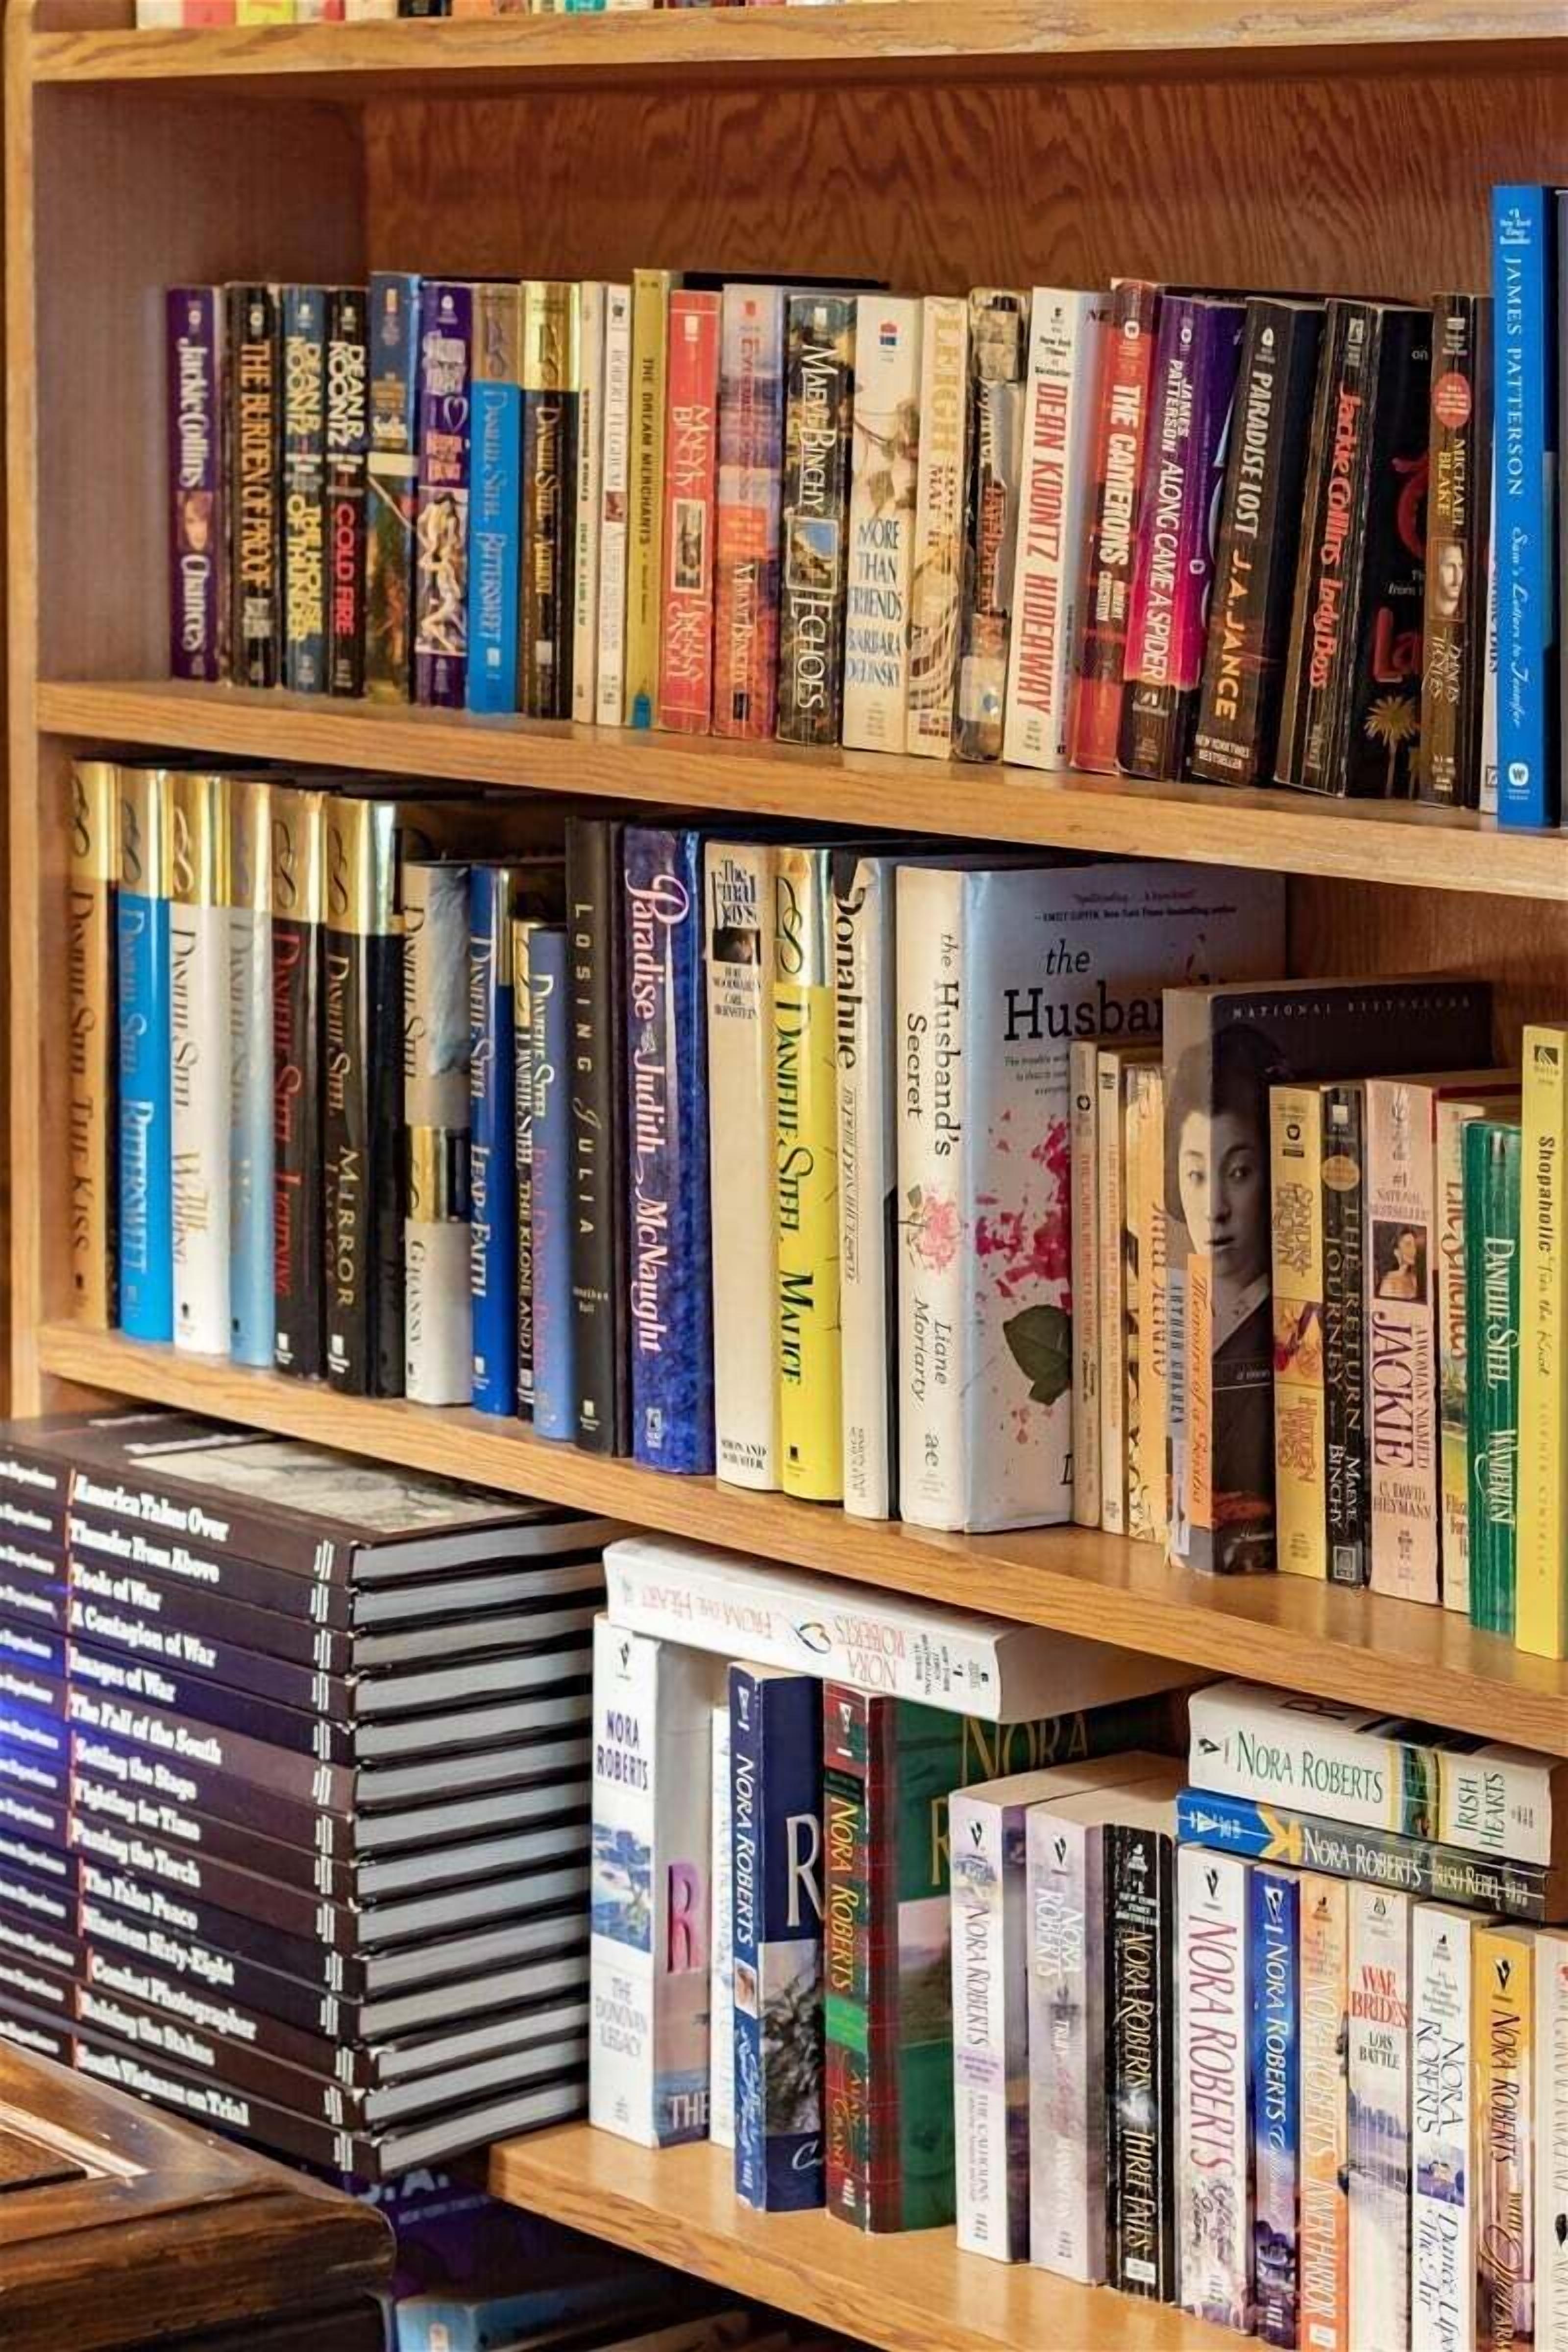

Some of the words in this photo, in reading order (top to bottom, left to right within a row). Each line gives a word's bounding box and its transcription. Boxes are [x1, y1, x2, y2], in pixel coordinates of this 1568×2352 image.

[1505, 257, 1522, 336] JAMES
[177, 338, 208, 411] Jackie
[242, 343, 270, 389] THE
[328, 342, 349, 446] KOONTZ
[640, 358, 654, 387] THE
[801, 343, 838, 427] MAEVE
[1161, 359, 1183, 452] PATTERSON
[241, 392, 270, 483] BURDEN
[640, 392, 654, 446] DREAM
[1033, 383, 1069, 450] DEAN
[1111, 385, 1140, 430] THE
[1177, 378, 1193, 438] JAMES
[1238, 370, 1274, 479] PARADISE
[1331, 391, 1363, 470] Jackie
[1506, 348, 1524, 496] PATTERSON
[180, 412, 210, 487] Collins
[800, 427, 836, 514] BINCHY
[1435, 450, 1453, 518] BLAKE
[1450, 438, 1467, 530] MICHAEL
[242, 486, 270, 514] OF
[639, 452, 654, 545] MERCHANTS
[1026, 460, 1064, 561] KOONTZ
[1099, 433, 1136, 565] CAMERONS
[1156, 459, 1184, 529] ALONG
[1233, 481, 1263, 539] LOST
[1320, 476, 1353, 566] Collins
[241, 517, 270, 588] PROOF
[335, 504, 355, 582] COLD
[1149, 533, 1177, 589] CAME
[1510, 527, 1529, 578] Sam's
[179, 554, 211, 653] Chances
[306, 550, 322, 636] HOUSE
[335, 586, 355, 636] FIRE
[1148, 590, 1172, 607] A
[1313, 577, 1344, 636] Lady
[791, 596, 833, 710] ECHOES
[1016, 574, 1057, 715] HIDEAWAY
[1142, 612, 1173, 680] SPIDER
[1213, 618, 1245, 720] JANCE
[1309, 636, 1339, 689] Boss
[1510, 644, 1525, 660] to
[1509, 663, 1531, 730] Jennifer
[64, 890, 95, 998] DANIELLE
[624, 869, 691, 1020] Paradise
[833, 886, 867, 1070] Donahue
[938, 933, 958, 967] the
[1044, 939, 1091, 975] the
[272, 932, 301, 1052] DANIELLE
[469, 935, 493, 1034] DANIELLE
[530, 973, 555, 1060] DANIELLE
[574, 902, 595, 1072] LOSING
[70, 1004, 97, 1078] STEEL
[471, 1038, 493, 1101] STEEL
[775, 1001, 812, 1137] DANIELLE
[906, 1012, 928, 1119] Secret
[932, 979, 961, 1158] Husband's
[69, 1095, 93, 1162] THE
[273, 1063, 301, 1143] STEEL
[532, 1065, 555, 1118] STEEL
[633, 1047, 668, 1186] Judith
[121, 1099, 155, 1276] BITTERSWEET
[518, 1181, 532, 1221] THE
[572, 1097, 602, 1234] JULIA
[776, 1136, 814, 1240] STEEL
[1536, 1134, 1557, 1253] Shopaholic
[71, 1175, 93, 1250] KISS
[274, 1168, 301, 1297] LIGHTNING
[337, 1144, 360, 1307] MIRROR
[1275, 1185, 1295, 1267] BROWN
[1294, 1186, 1314, 1277] SANDRA
[1344, 1206, 1363, 1270] THE
[406, 1240, 425, 1347] GRANNY
[518, 1226, 532, 1290] KLONE
[630, 1186, 668, 1355] McNaught
[1484, 1236, 1516, 1326] DANIELLE
[518, 1304, 532, 1347] AND
[778, 1270, 814, 1386] MALICE
[1189, 1272, 1208, 1381] Memoirs
[1325, 1237, 1345, 1393] JOURNEY
[1536, 1295, 1553, 1322] the
[910, 1297, 929, 1402] Moriarty
[931, 1320, 953, 1386] Liane
[1345, 1290, 1362, 1432] RETURN
[1485, 1325, 1519, 1391] STEEL
[1372, 1310, 1414, 1469] JACKIE
[1327, 1444, 1345, 1530] BINCHY
[1343, 1455, 1362, 1523] MAEVE
[71, 1601, 84, 1625] A
[85, 1605, 165, 1649] Contagion
[165, 1633, 182, 1657] of
[182, 1634, 217, 1668] War
[112, 1578, 128, 1599] of
[128, 1579, 162, 1612] War
[124, 1667, 142, 1690] of
[141, 1669, 176, 1703] War
[71, 1691, 101, 1722] The
[102, 1703, 131, 1728] Fall
[131, 1716, 149, 1739] of
[150, 1723, 176, 1746] the
[176, 1735, 222, 1766] South
[604, 1708, 640, 1753] NORA
[957, 1713, 1092, 1788] NORA
[1236, 1730, 1294, 1784] NORA
[1301, 1750, 1384, 1805] ROBERTS
[595, 1743, 649, 1794] ROBERTS
[735, 1753, 755, 1833] NORA
[1455, 1776, 1479, 1834] IRISH
[830, 1796, 859, 1873] NORA
[1479, 1771, 1506, 1849] HEARTS
[735, 1834, 755, 1946] ROBERTS
[1303, 1827, 1350, 1870] NORA
[1355, 1844, 1422, 1887] ROBERTS
[831, 1884, 859, 1993] ROBERTS
[963, 1905, 990, 1963] NORA
[1034, 1887, 1064, 1980] ROBERTS
[1058, 1909, 1086, 1975] NORA
[1121, 1929, 1155, 1995] NORA
[1186, 1915, 1237, 2012] NORA
[965, 1966, 990, 2047] ROBERTS
[1265, 1940, 1289, 2009] NORA
[1361, 1964, 1396, 1994] WAR
[1119, 1995, 1155, 2091] ROBERTS
[1265, 2015, 1289, 2122] ROBERTS
[1417, 2017, 1444, 2138] ROBERTS
[1489, 2009, 1521, 2071] NORA
[186, 2088, 206, 2107] on
[205, 2090, 250, 2126] Trial
[1187, 2022, 1237, 2171] ROBERTS
[1440, 2035, 1465, 2128] NORA
[1490, 2078, 1520, 2163] ROBERTS
[1418, 2262, 1438, 2307] Air
